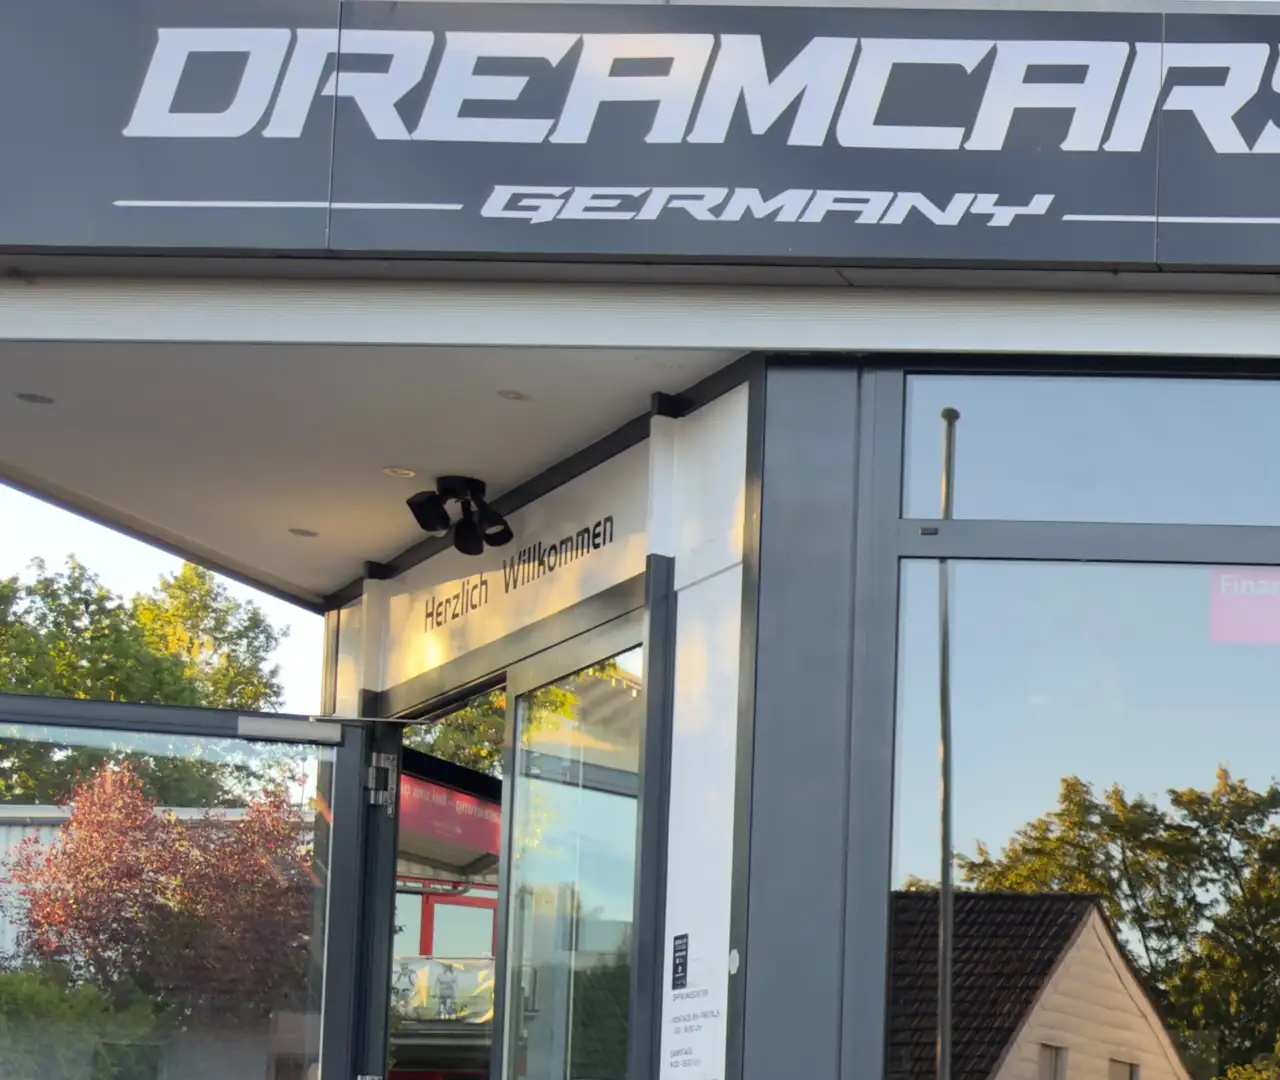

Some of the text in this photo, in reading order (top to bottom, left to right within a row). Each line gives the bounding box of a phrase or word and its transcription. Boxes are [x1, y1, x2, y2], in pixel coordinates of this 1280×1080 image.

[480, 184, 1055, 227] GERMANY
[424, 515, 614, 633] Herzlich Willkommen
